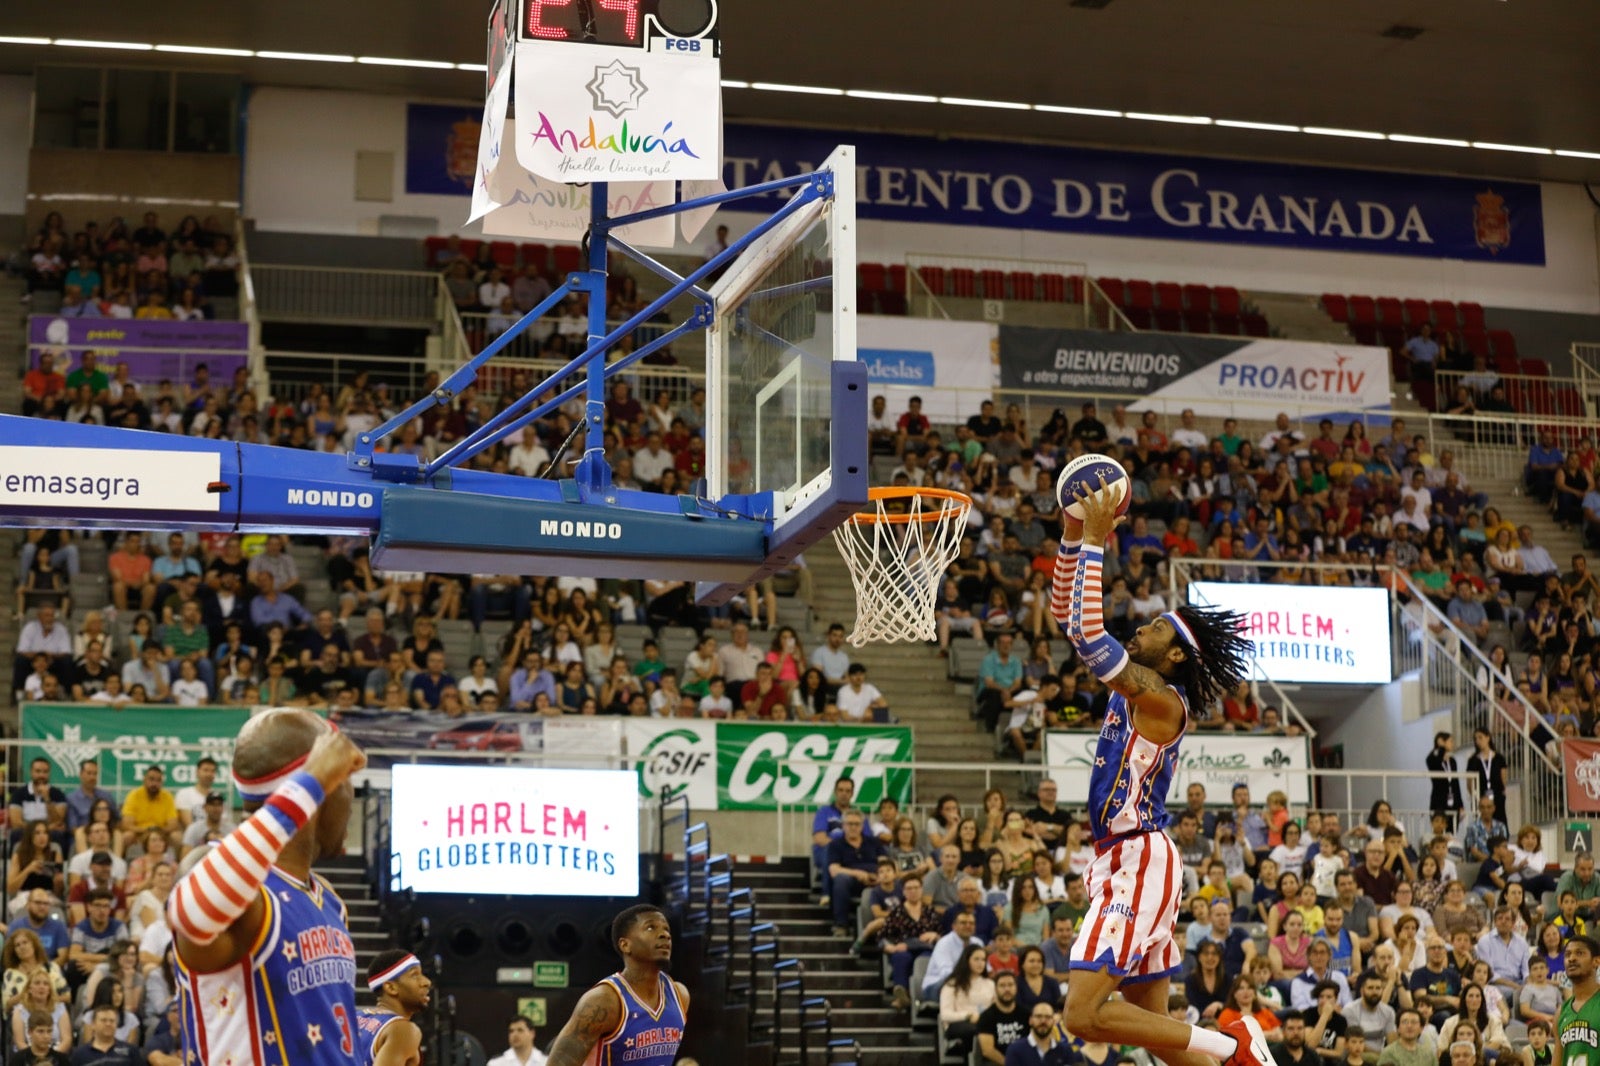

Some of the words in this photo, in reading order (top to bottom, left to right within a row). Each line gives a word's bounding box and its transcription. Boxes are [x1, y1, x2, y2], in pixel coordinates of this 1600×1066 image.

[530, 111, 701, 159] Andalucía
[558, 154, 604, 174] Huella
[609, 158, 671, 176] Universal
[724, 156, 1033, 216] TAIENTO
[1052, 178, 1130, 222] DE
[1054, 348, 1181, 376] BIENVENIDOS
[1133, 376, 1148, 389] de
[1218, 361, 1365, 394] PROACTIV
[0, 474, 139, 500] emasagra
[287, 488, 374, 509] MONDO
[540, 519, 622, 540] MONDO
[111, 735, 190, 762] CAJA
[649, 750, 710, 776] CSIF
[729, 731, 901, 803] CSIF
[447, 802, 587, 841] HARLEM
[1572, 830, 1586, 851] A
[418, 841, 615, 876] GLOBETROTTERS
[1102, 903, 1135, 922] HARLEM
[636, 1027, 680, 1048] HARLEM
